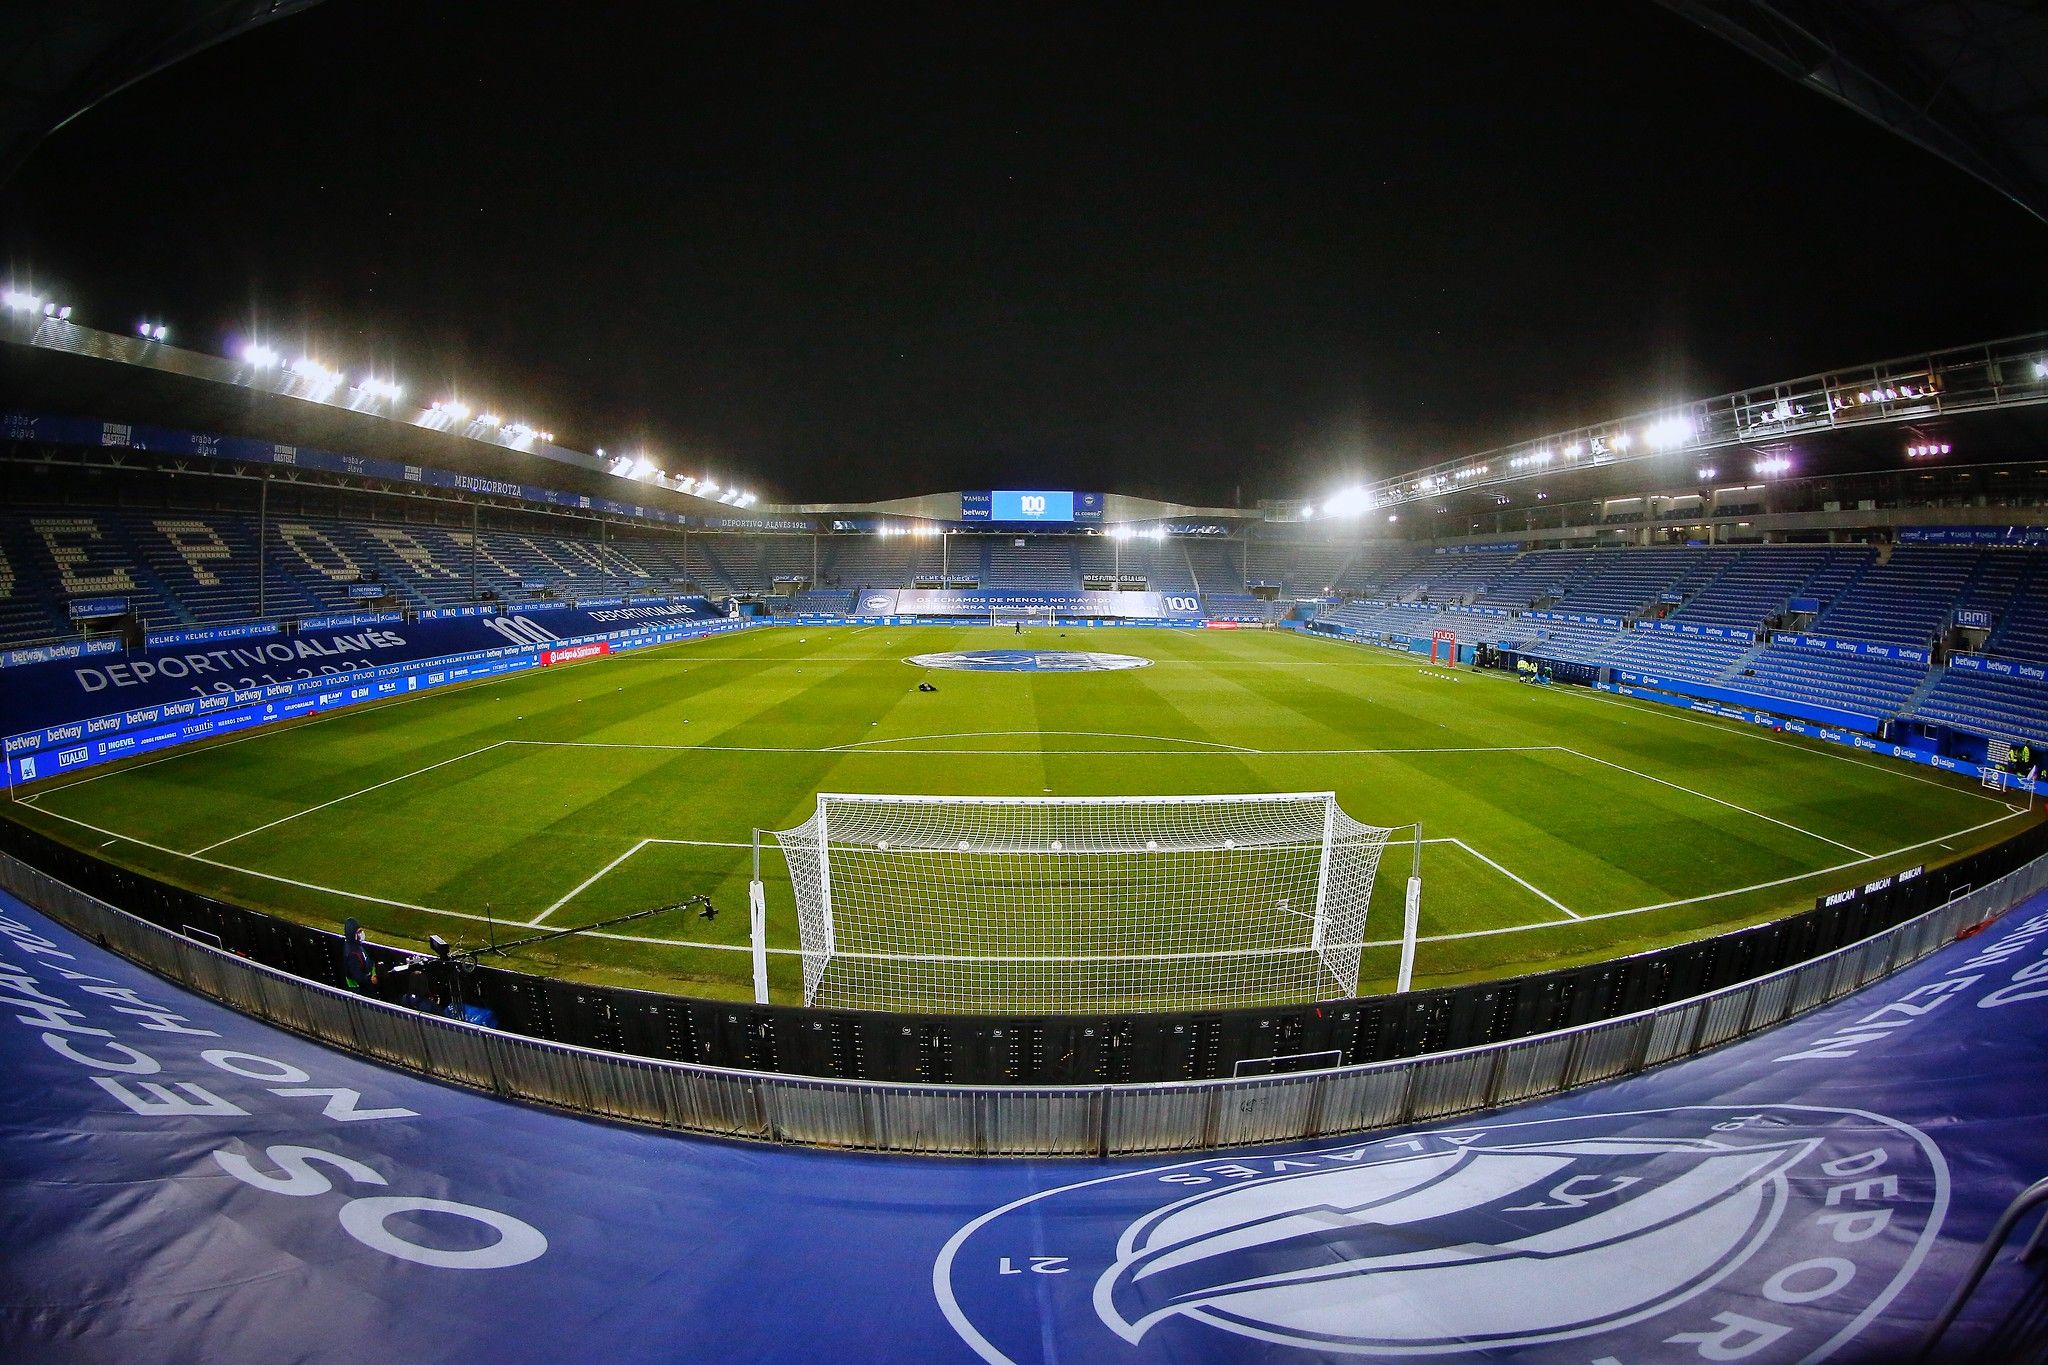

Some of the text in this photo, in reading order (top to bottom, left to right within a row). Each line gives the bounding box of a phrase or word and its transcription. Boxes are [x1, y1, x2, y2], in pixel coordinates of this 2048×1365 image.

[454, 476, 522, 497] MENDIZORROTZA
[963, 508, 988, 516] betway
[1020, 496, 1046, 512] 100
[442, 608, 456, 616] IMQ
[462, 607, 476, 615] IMQ
[480, 606, 492, 614] IMQ
[1165, 597, 1198, 610] 100
[1682, 624, 1699, 634] betway
[1706, 627, 1724, 637] betway
[1730, 630, 1748, 640] betway
[50, 644, 80, 658] betway
[86, 640, 116, 653] betway
[1778, 634, 1922, 660] betway betway betway betway betway
[1955, 656, 2045, 678] betway betway betway
[358, 688, 368, 697] BM
[6, 734, 41, 752] betway
[48, 725, 82, 742] betway
[88, 717, 120, 733] betway
[126, 709, 158, 724] betway
[164, 702, 194, 717] betway
[200, 696, 229, 710] betway
[234, 689, 262, 702] betway
[266, 684, 293, 696] betway
[182, 719, 214, 734] vivantis
[108, 738, 135, 750] INGEVEL
[1760, 718, 1955, 768] LaLiga LaLiga LaLiga LaLiga LaLiga LaLiga
[60, 749, 86, 764] VIALKI
[201, 1049, 421, 1122] NO
[1158, 1131, 1488, 1186] ALAVÉS
[213, 1145, 549, 1269] OS
[999, 1255, 1069, 1275] 21
